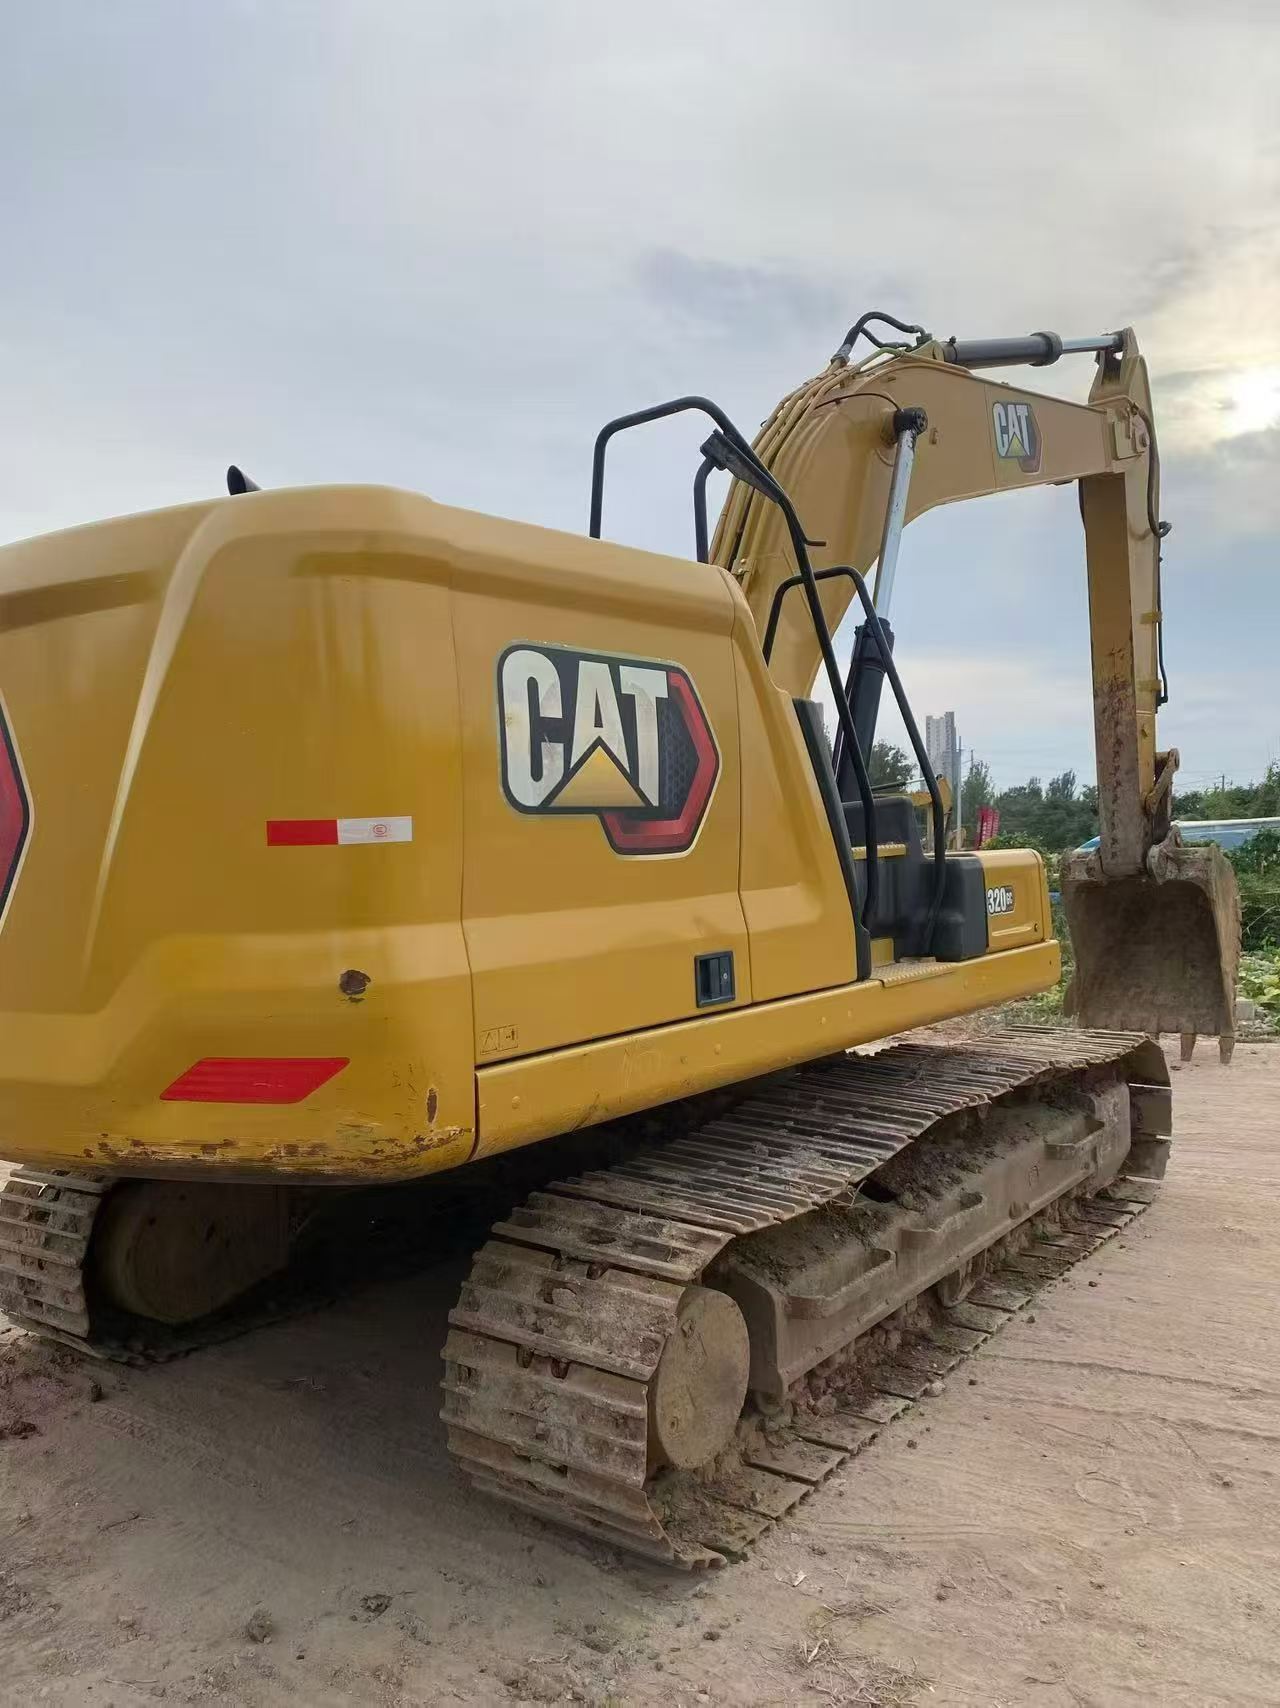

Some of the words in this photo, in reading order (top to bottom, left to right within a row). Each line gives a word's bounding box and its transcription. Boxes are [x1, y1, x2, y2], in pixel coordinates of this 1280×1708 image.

[993, 402, 1030, 457] CAT
[502, 649, 669, 807] CAT
[987, 887, 1006, 913] 320
